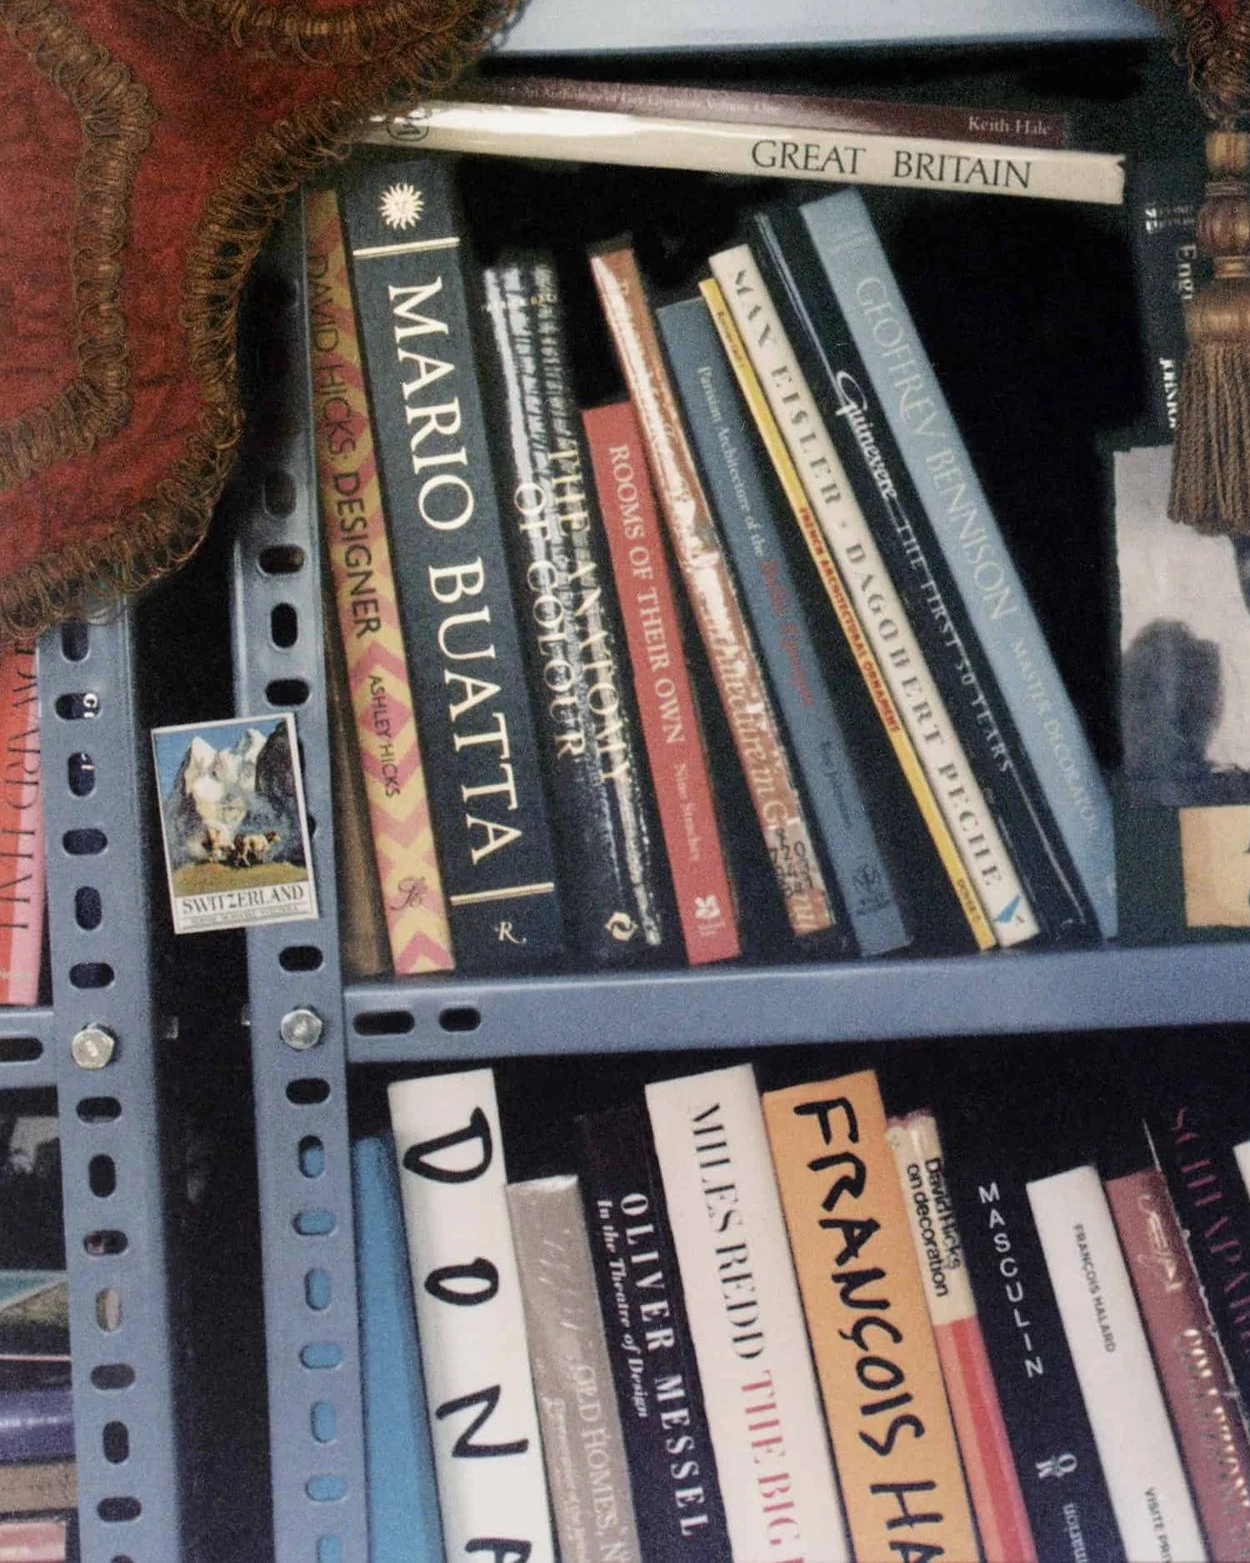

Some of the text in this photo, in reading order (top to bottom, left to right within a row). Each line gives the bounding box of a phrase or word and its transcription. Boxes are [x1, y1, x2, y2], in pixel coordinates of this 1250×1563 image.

[751, 139, 1031, 188] GREAT BRITAIN
[968, 115, 1050, 136] Keith Hale
[301, 250, 341, 353] DAVID
[331, 470, 382, 638] DESIGNER
[695, 363, 771, 558] Parisian Architecture of the
[848, 273, 1104, 837] GEOFFREY BENNISON MASTER DECORATOR
[379, 276, 532, 865] MARIO BUATTA
[509, 479, 592, 760] OF COLOUR
[543, 439, 636, 788] THE ANATOMY
[606, 443, 688, 745] ROOMS OF THEIR OWN
[726, 267, 779, 355] MAX
[767, 363, 844, 508] EISLER
[842, 541, 948, 752] DAGOBERT
[935, 760, 1005, 887] PECHE
[798, 505, 902, 734] FRENCH ARCHITECTURAL ORNAMENT
[821, 367, 1015, 775] Guinevere THE FIRST 50 YEARS
[366, 674, 400, 797] ASHLEY HICKS
[182, 885, 304, 916] SWITZERLAND
[594, 1196, 656, 1420] In the Theatre of Design
[687, 1100, 802, 1547] MILES REDD THE BIG
[786, 1091, 930, 1461] FRANÇOIS
[905, 1162, 952, 1298] on decoration
[926, 1156, 967, 1271] David Hicks
[976, 1179, 1047, 1379] MASCULIN
[1070, 1223, 1117, 1354] FRANÇOIS HALARD
[570, 1363, 604, 1423] OLD
[618, 1189, 711, 1540] OLIVER MESSEL
[1142, 1487, 1166, 1535] VISITE
